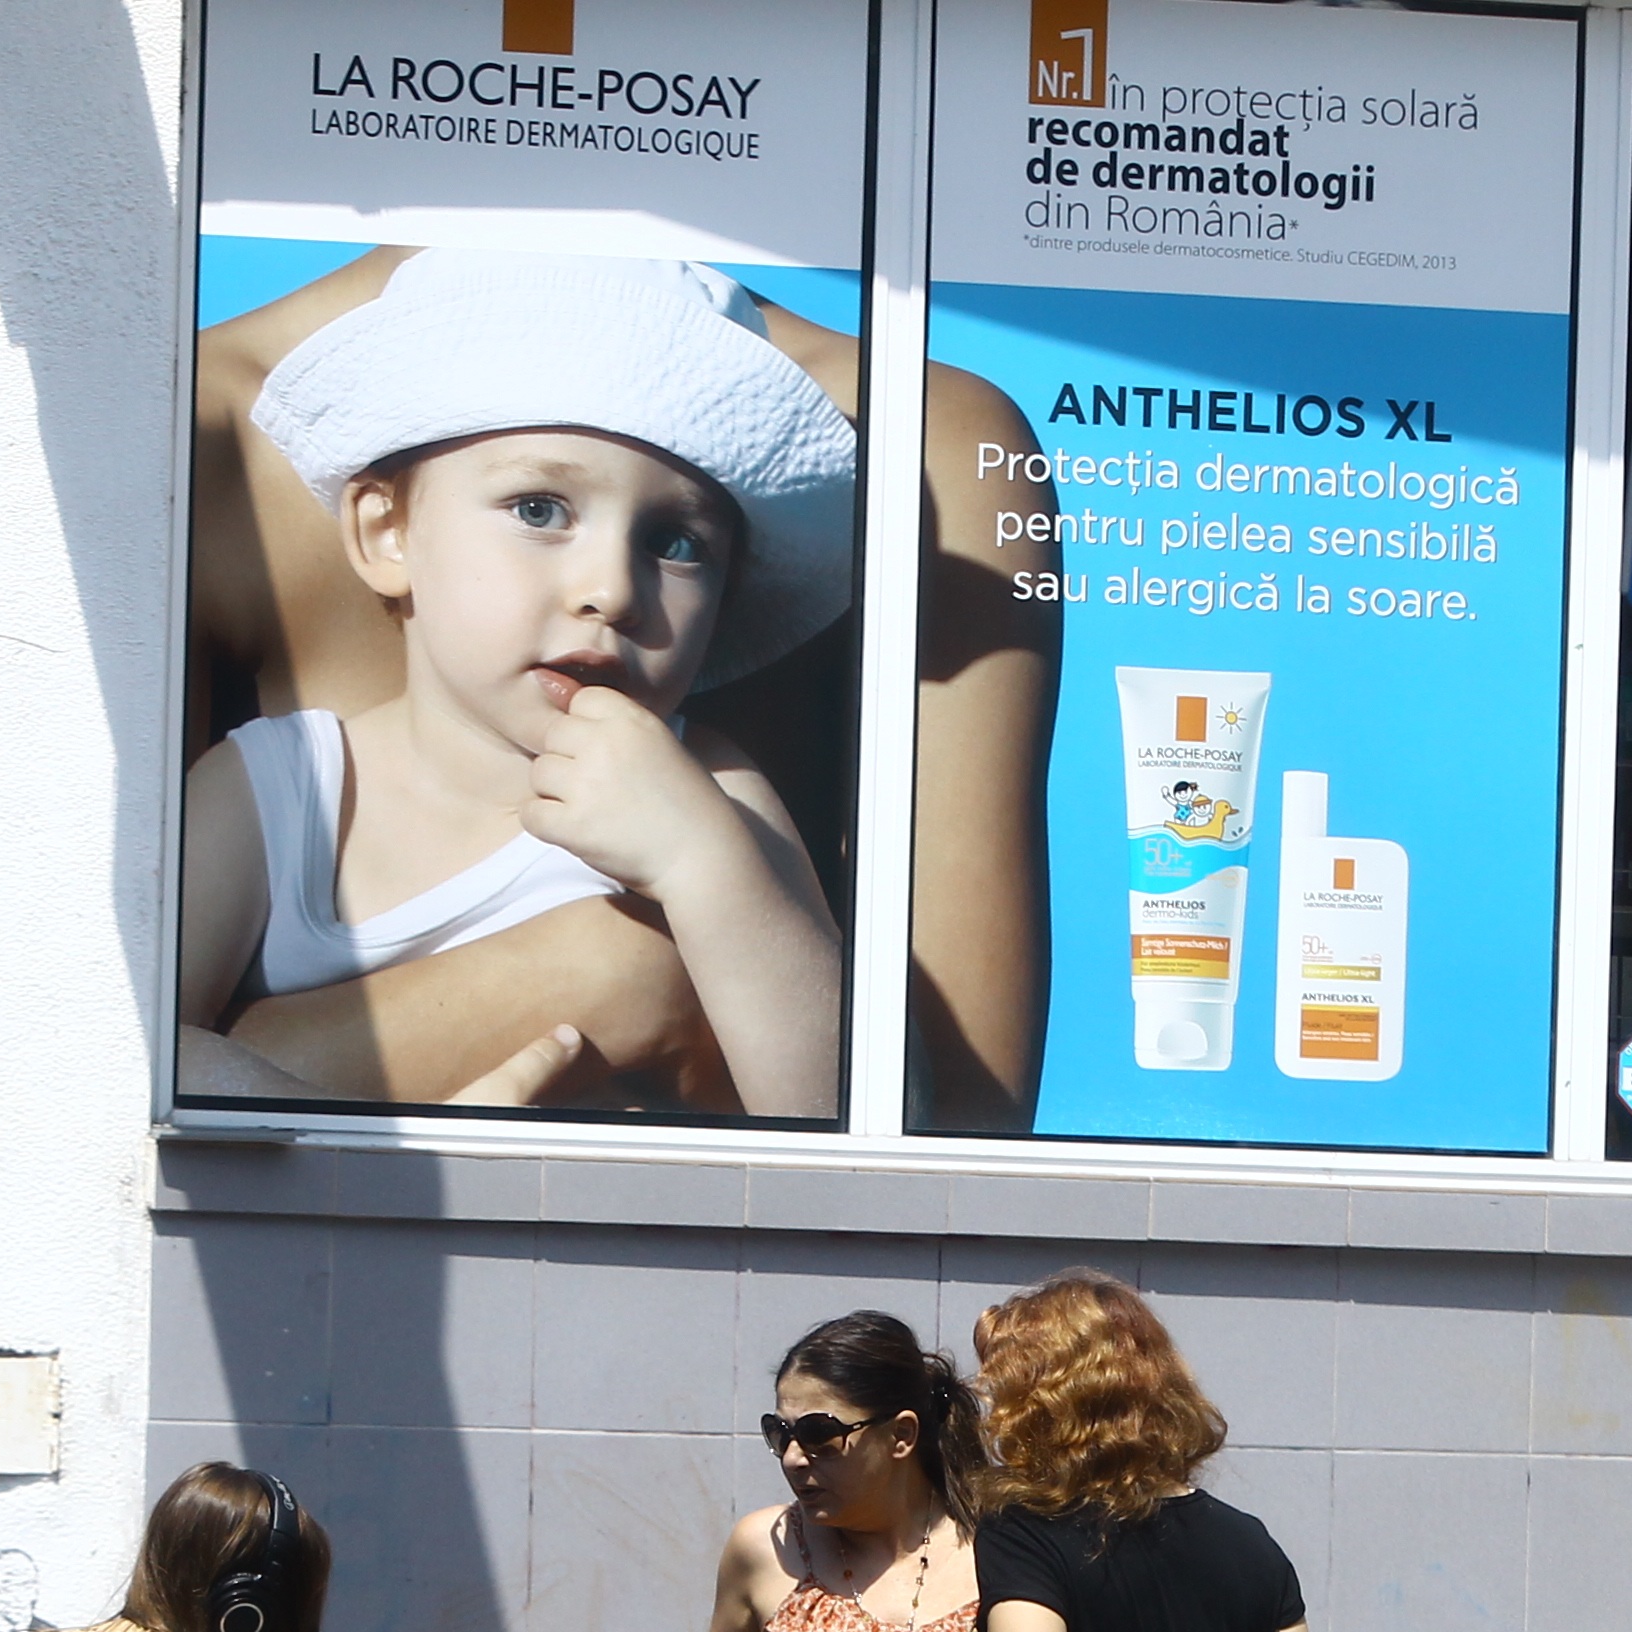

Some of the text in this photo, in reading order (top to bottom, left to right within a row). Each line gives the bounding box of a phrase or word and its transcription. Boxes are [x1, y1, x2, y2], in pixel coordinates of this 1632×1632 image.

[312, 53, 761, 120] LA ROCHE-POSAY
[1108, 73, 1145, 111] în
[1361, 88, 1479, 130] solară
[311, 108, 760, 160] LABORATOIRE DERMATOLOGIQUE
[1027, 115, 1290, 158] recomandat
[1025, 147, 1376, 210] de dermatologii
[1024, 190, 1090, 230] din
[1076, 238, 1150, 257] produsele
[1153, 241, 1294, 263] dermatocosmetice.
[1295, 247, 1343, 266] Studiu
[1346, 250, 1419, 270] CEGEDIM,
[1421, 254, 1457, 270] 2013
[1049, 382, 1453, 443] ANTHELIOS XL
[1196, 452, 1520, 510] dermatologică
[995, 510, 1498, 564] pentru pielea sensibilă
[1011, 567, 1478, 620] sau alergică la soare.
[1138, 748, 1244, 763] LA ROCHE-POSAY
[1143, 837, 1185, 866] 50+
[1142, 900, 1206, 910] ANTHELIOS
[1318, 893, 1383, 904] ROCHE-POSAY
[1301, 993, 1375, 1005] ANTHELIOS XL
